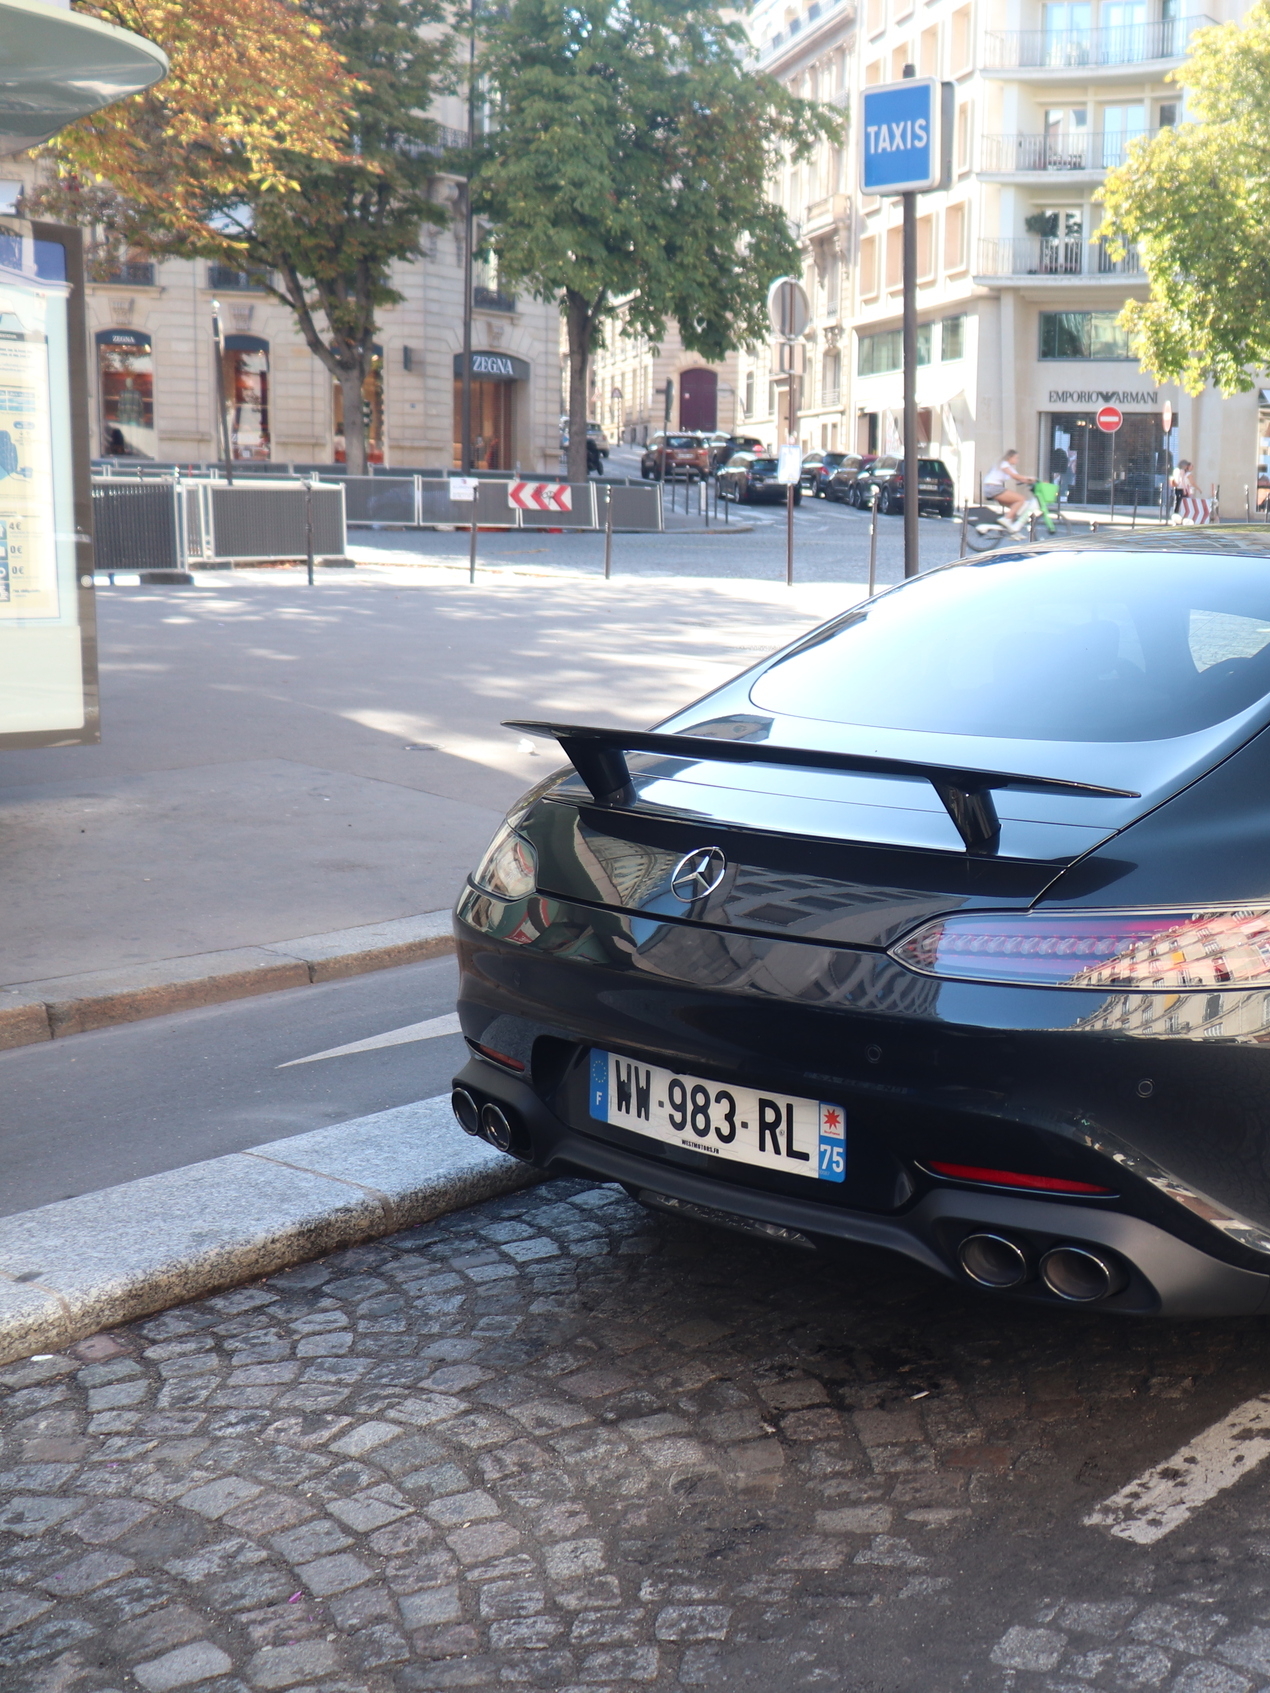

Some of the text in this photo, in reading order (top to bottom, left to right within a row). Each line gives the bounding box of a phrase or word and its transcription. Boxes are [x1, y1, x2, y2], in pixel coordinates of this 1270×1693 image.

[866, 118, 928, 154] TAXIS
[112, 335, 136, 344] ZEGNA
[472, 355, 514, 375] ZEGNA
[1048, 390, 1158, 404] EMPORIO ARMANI
[596, 1091, 603, 1106] F
[819, 1144, 844, 1173] 75
